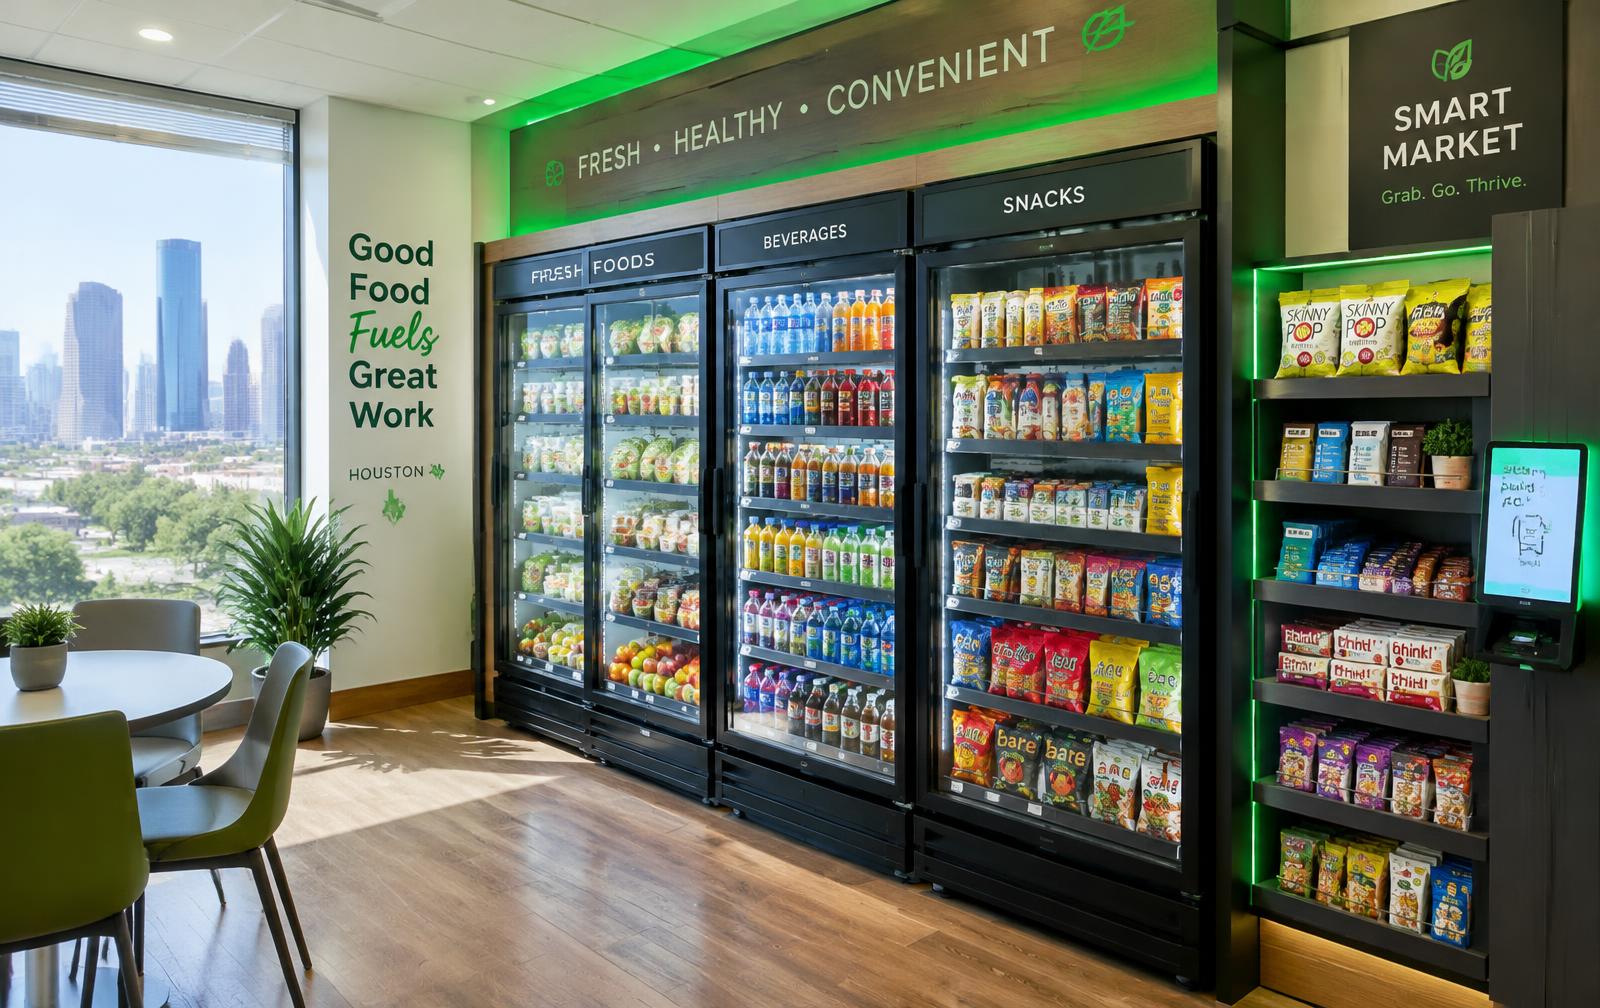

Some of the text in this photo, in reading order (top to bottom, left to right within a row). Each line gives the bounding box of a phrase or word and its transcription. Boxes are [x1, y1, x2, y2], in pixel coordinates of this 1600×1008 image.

[578, 26, 1055, 179] FRESH HEALTHY CONVENIENT
[1394, 86, 1512, 132] SMART
[1383, 123, 1523, 170] MARKET
[1003, 185, 1086, 214] SNACKS
[1381, 175, 1527, 205] Grab. Go. Thrive.
[349, 233, 434, 267] Good
[763, 224, 848, 250] BEVERAGES
[593, 252, 655, 275] FOODS
[350, 272, 430, 305] Food
[1286, 307, 1331, 323] SKINNY
[1346, 301, 1395, 318] SKINNY
[349, 310, 439, 357] Fuels
[349, 360, 437, 389] Great
[349, 401, 434, 428] Work
[349, 465, 424, 481] HOUSTON
[997, 728, 1037, 754] bare
